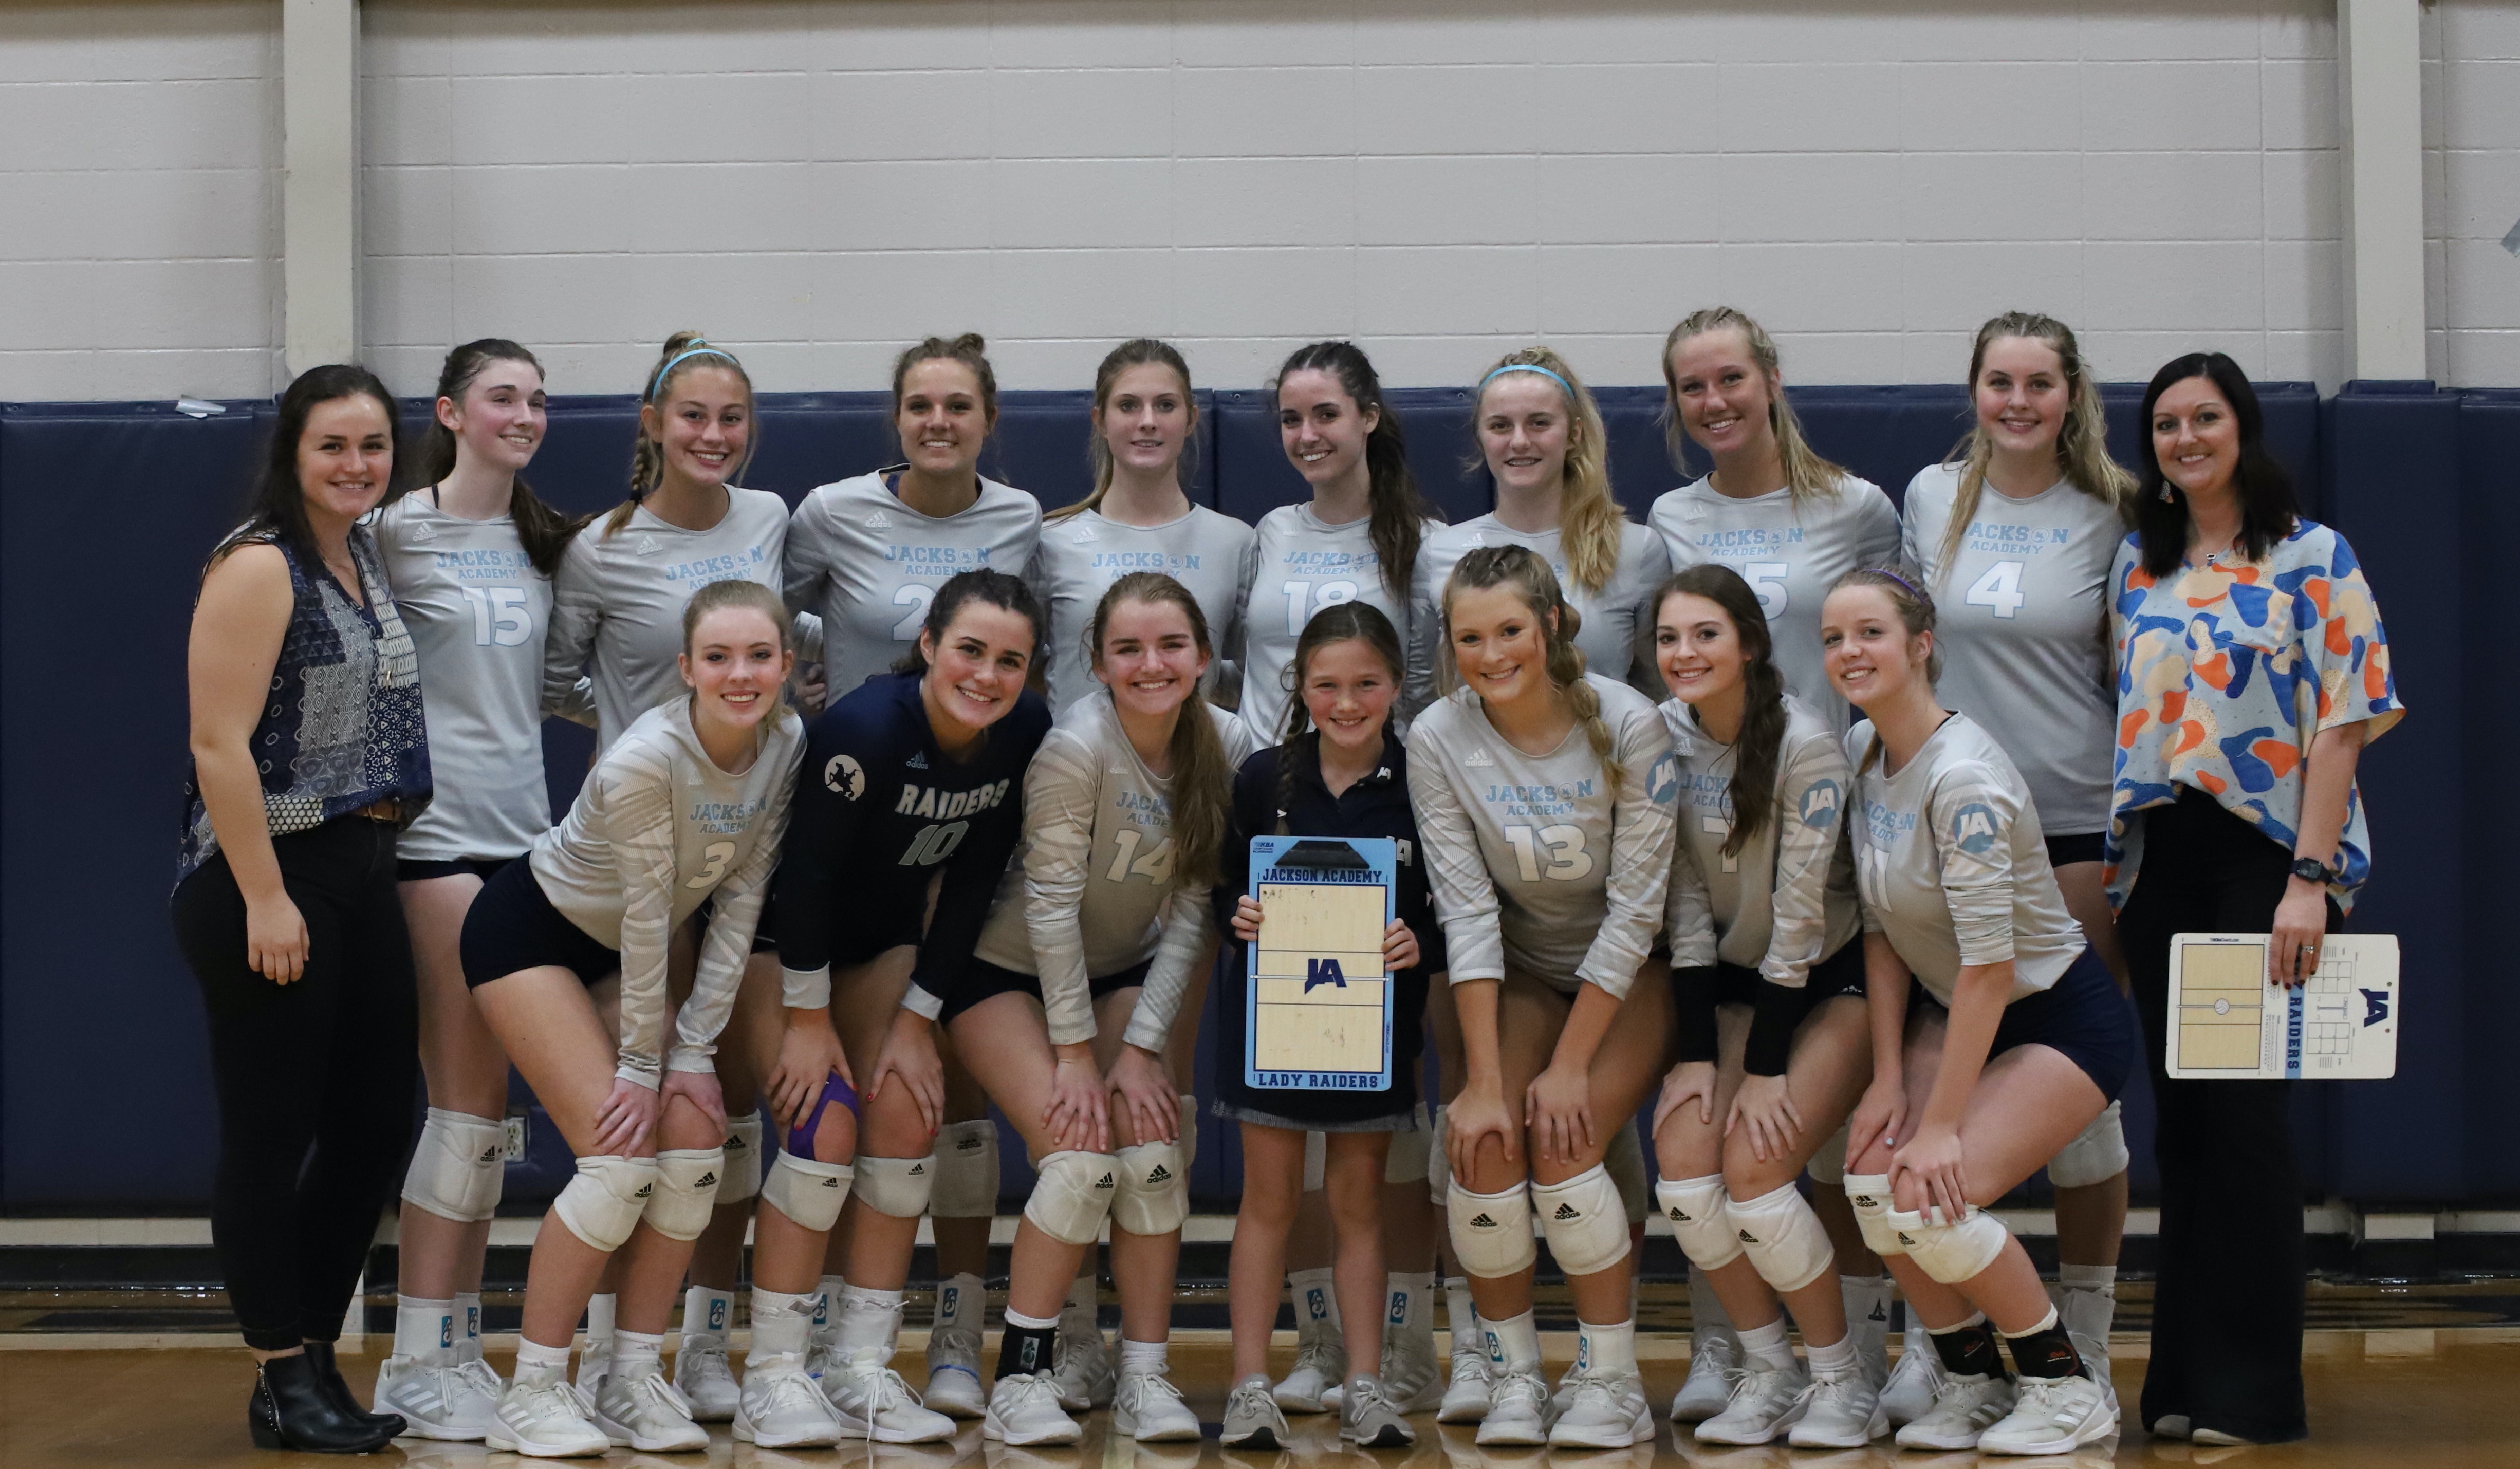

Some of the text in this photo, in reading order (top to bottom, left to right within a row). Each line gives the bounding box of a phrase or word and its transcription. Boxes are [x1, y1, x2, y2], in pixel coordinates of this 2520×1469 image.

[413, 529, 437, 541] adidas
[1962, 522, 2069, 544] ACKSON
[637, 543, 663, 555] adidas
[1710, 545, 1781, 557] ACADEMY
[1969, 540, 2044, 555] ACADEMY
[457, 568, 517, 580] ACADEMY
[1292, 566, 1364, 575] ACADEMY
[1721, 563, 1789, 620] 5
[1965, 560, 2025, 619] 4
[461, 586, 533, 647] 15
[905, 760, 928, 770] adidas
[894, 778, 1010, 820] RAIDERS
[1505, 802, 1574, 816] ACADEMY
[898, 821, 970, 866] 10
[1106, 829, 1177, 886] 14
[1504, 824, 1593, 882] 13
[685, 841, 736, 889] 3
[1263, 868, 1382, 883] JACKSON ACADEMY
[1860, 842, 1893, 913] 11
[2287, 996, 2303, 1070] RAIDERS
[1258, 1073, 1378, 1088] LADY RAIDERS
[1147, 1173, 1172, 1183] adidas
[1554, 1212, 1581, 1220] adidas
